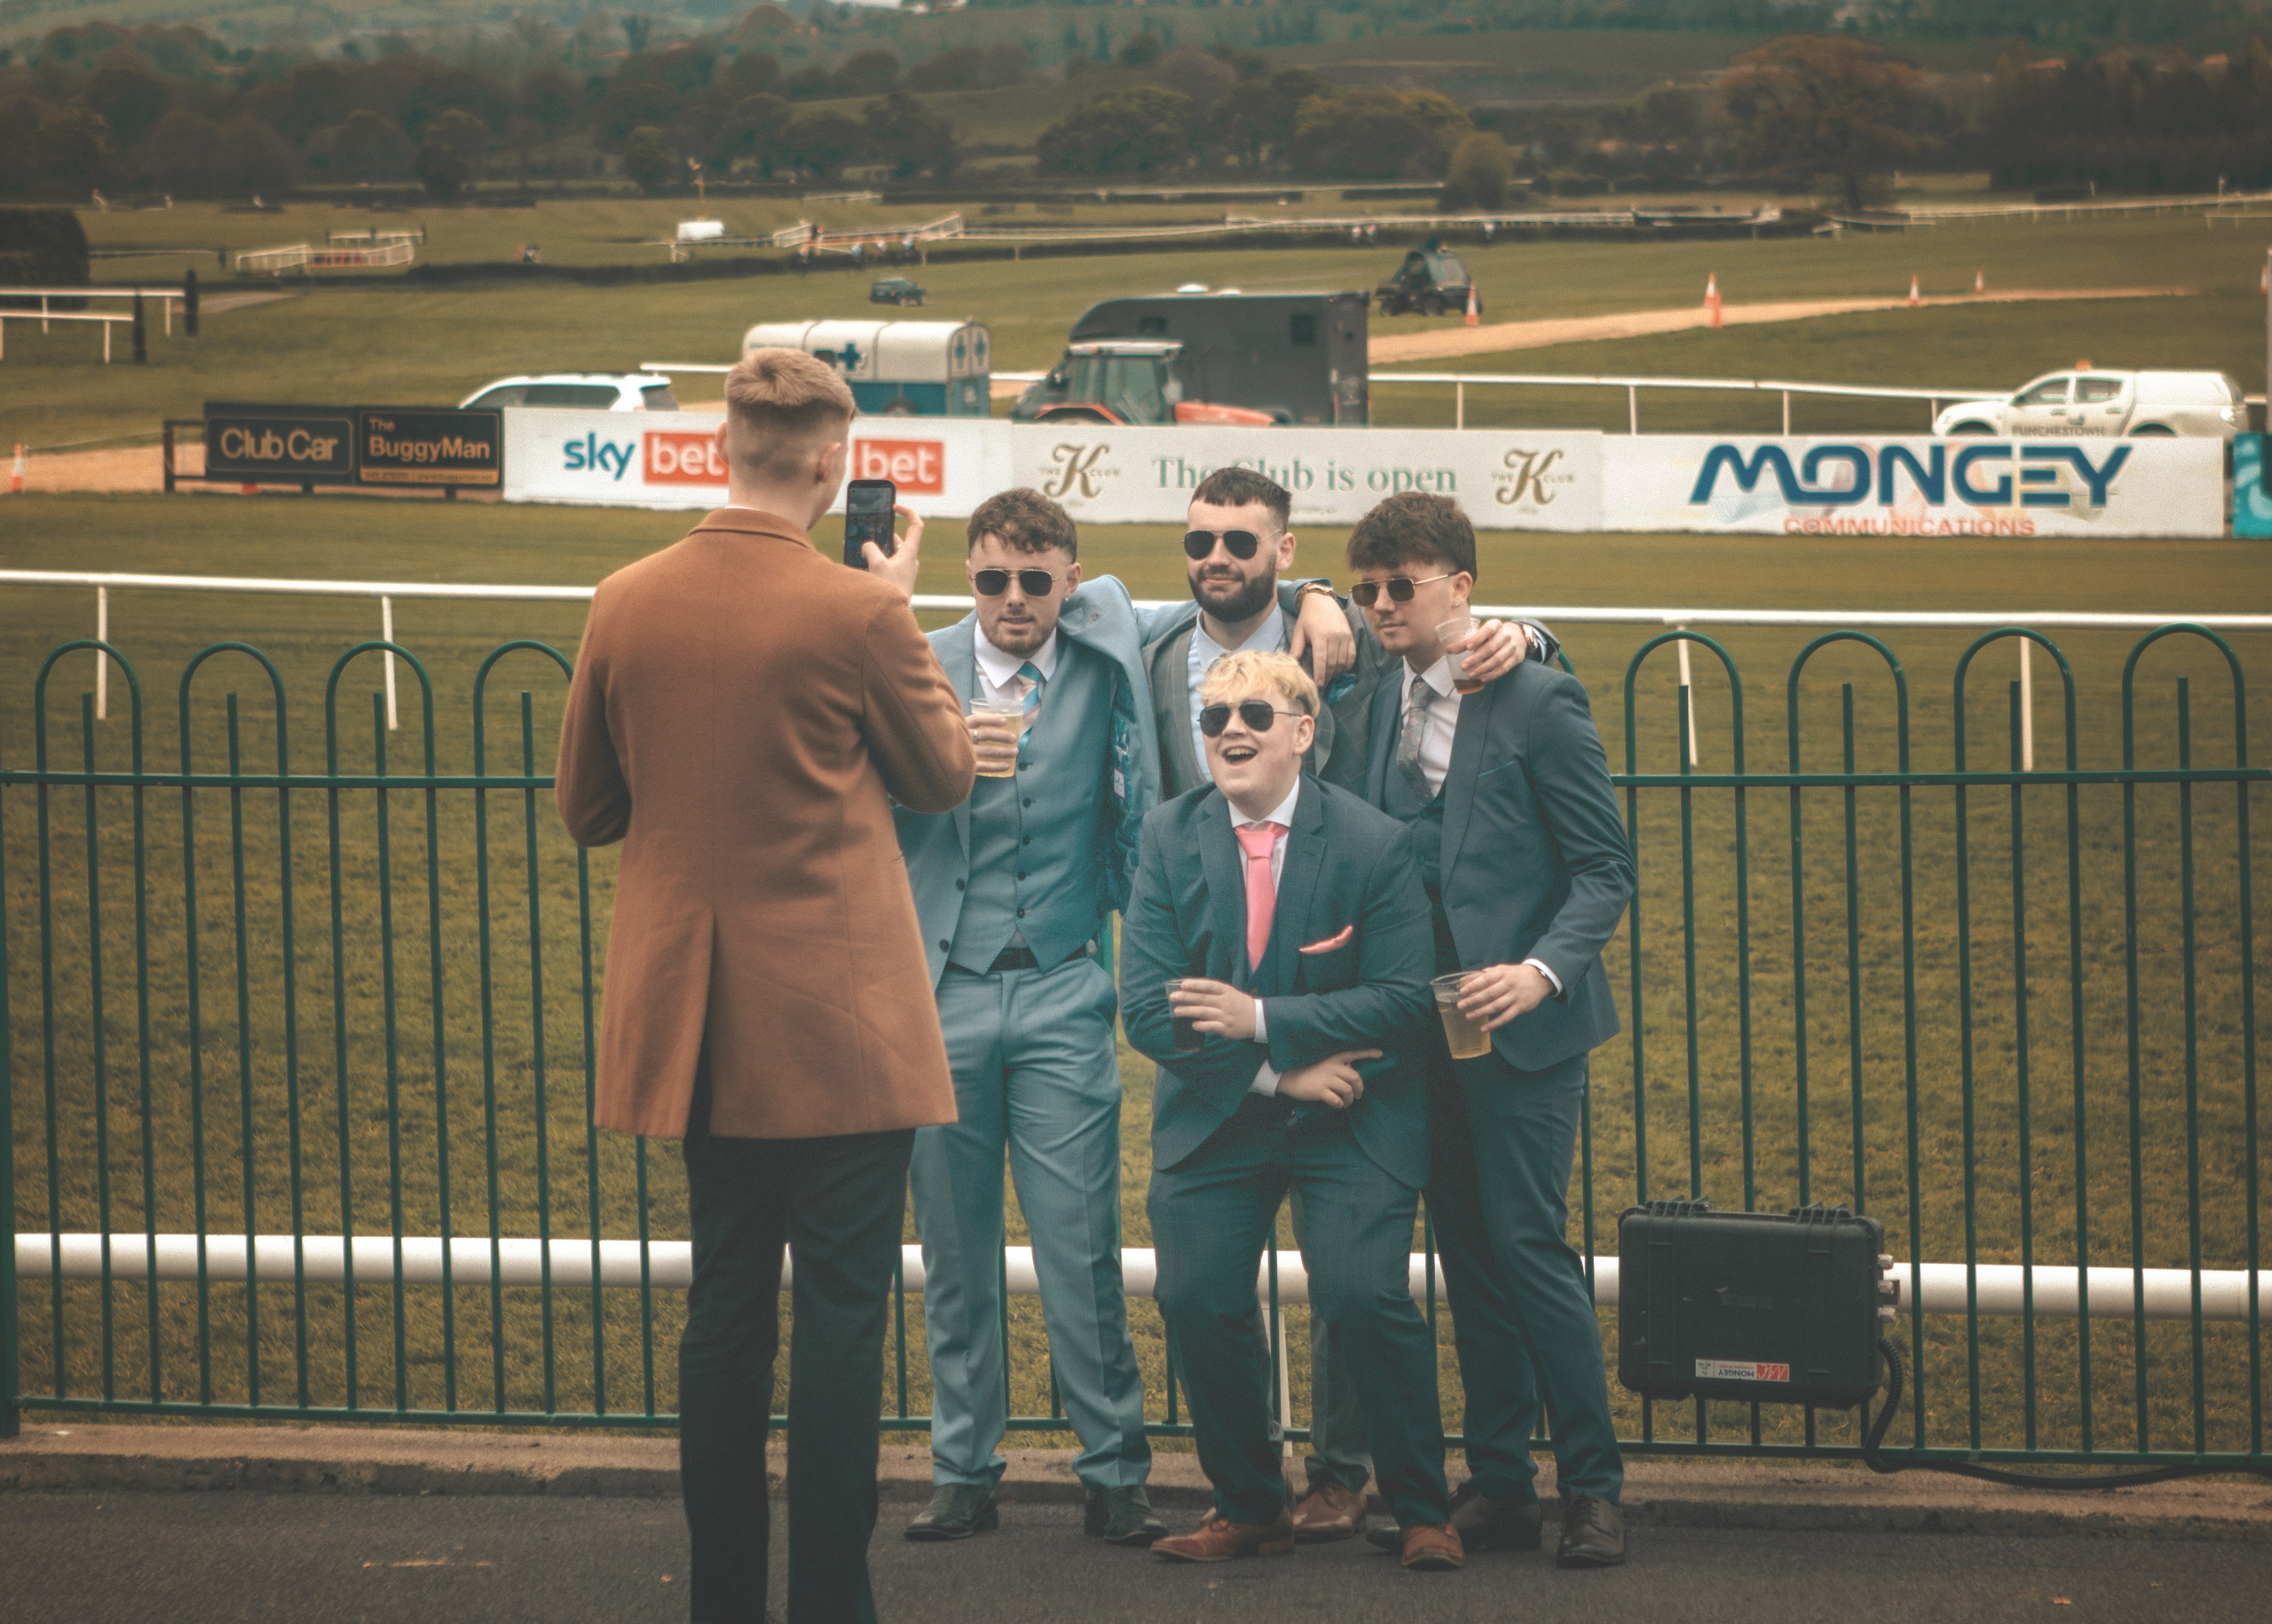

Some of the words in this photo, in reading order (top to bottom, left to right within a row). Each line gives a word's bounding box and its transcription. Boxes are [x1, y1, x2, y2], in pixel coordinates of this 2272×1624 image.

[369, 418, 395, 432] The
[221, 428, 284, 460] Club
[288, 430, 339, 461] Car
[369, 436, 491, 461] BuggyMan
[564, 431, 635, 481] sky
[651, 435, 725, 477] bet
[861, 441, 937, 485] bet
[1044, 442, 1111, 500] K
[1328, 460, 1355, 492] is
[1367, 469, 1456, 496] open
[1495, 448, 1565, 506] K
[1688, 444, 2134, 508] MONGEY
[1782, 517, 2036, 538] COMMUNICATIONS
[1718, 1368, 1755, 1377] MONGEY
